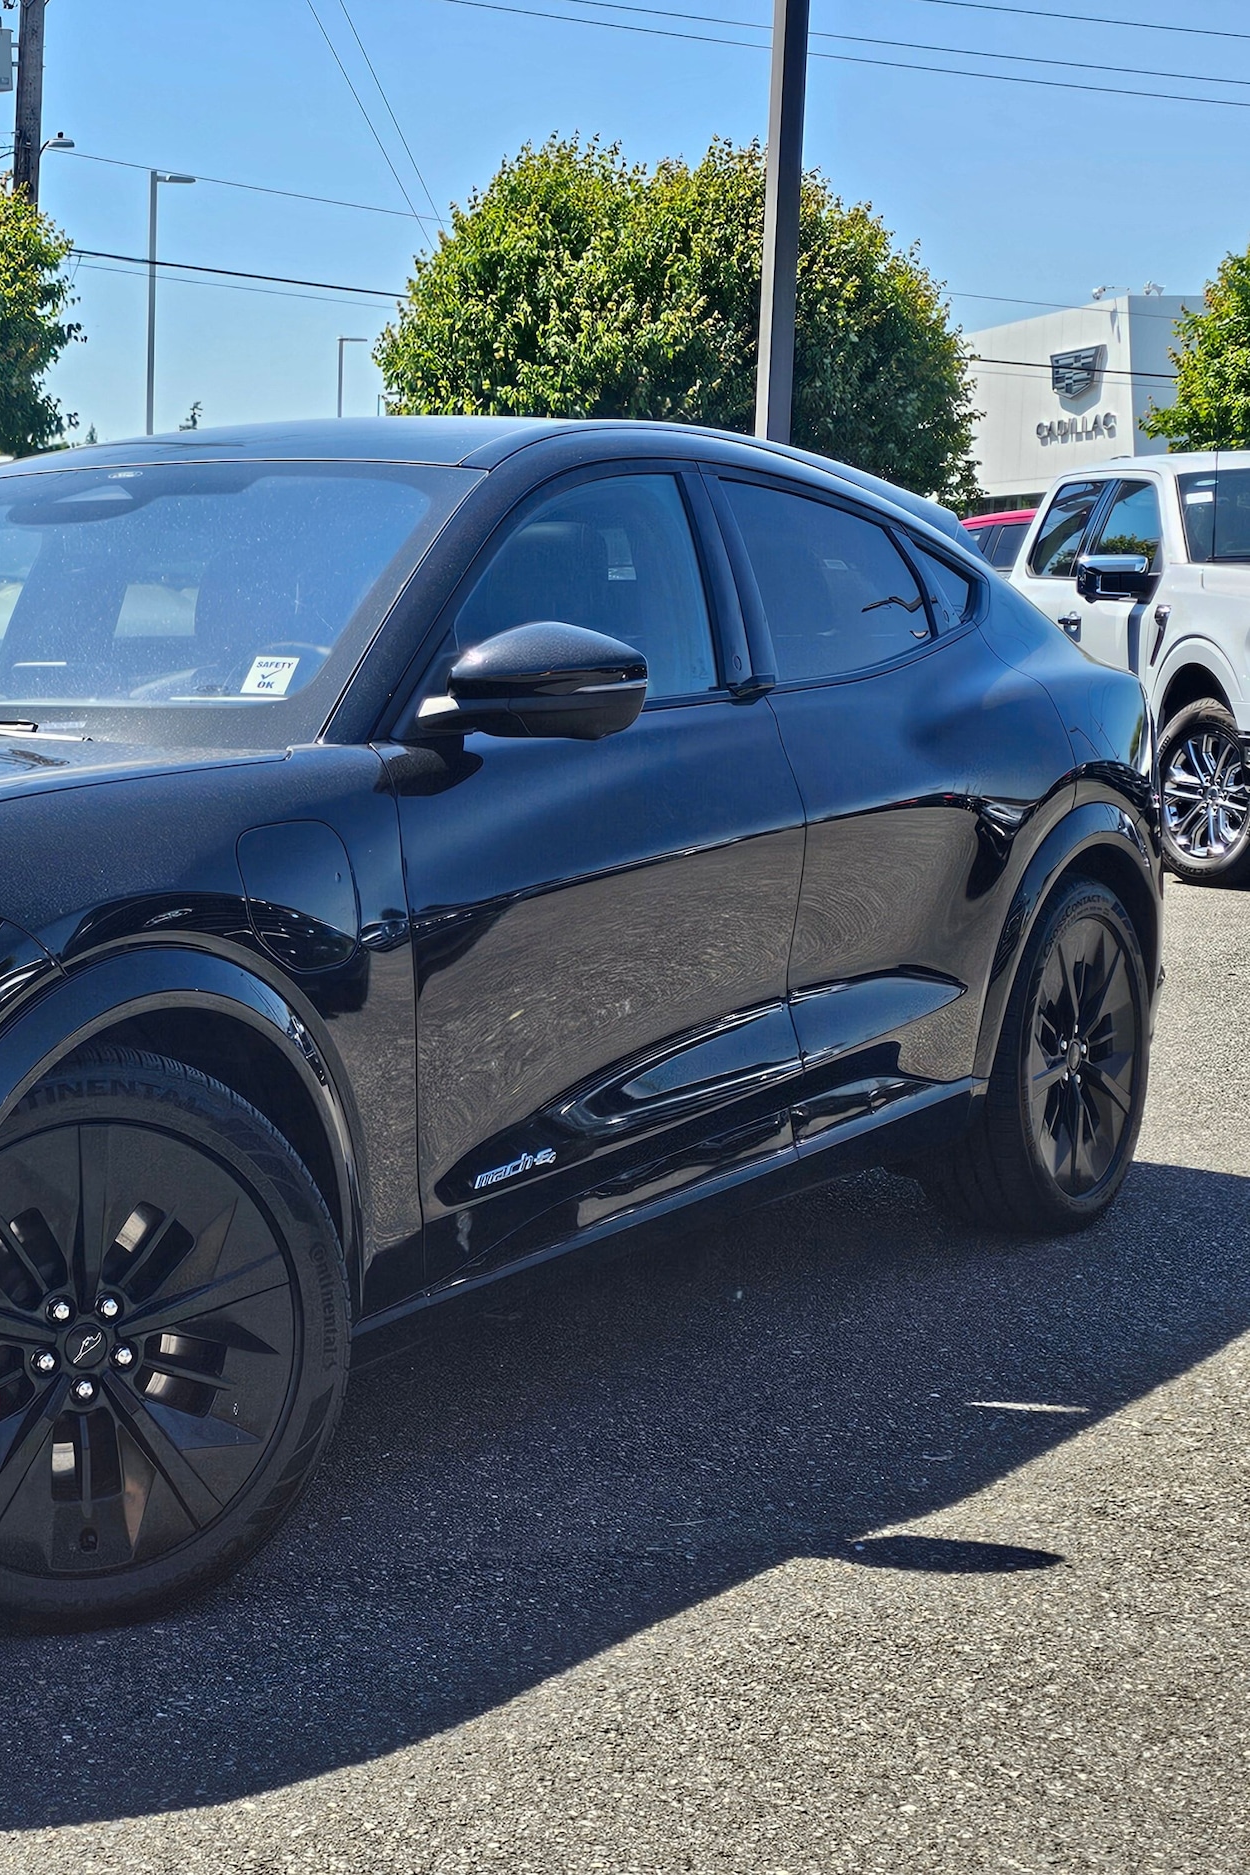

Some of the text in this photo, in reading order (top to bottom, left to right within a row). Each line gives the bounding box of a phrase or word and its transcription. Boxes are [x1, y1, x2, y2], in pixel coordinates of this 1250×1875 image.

[1036, 412, 1117, 439] CADILLAC
[256, 661, 294, 669] SAFETY
[257, 681, 275, 689] OK
[18, 1079, 199, 1115] TINENTAL
[308, 1241, 338, 1353] Continental
